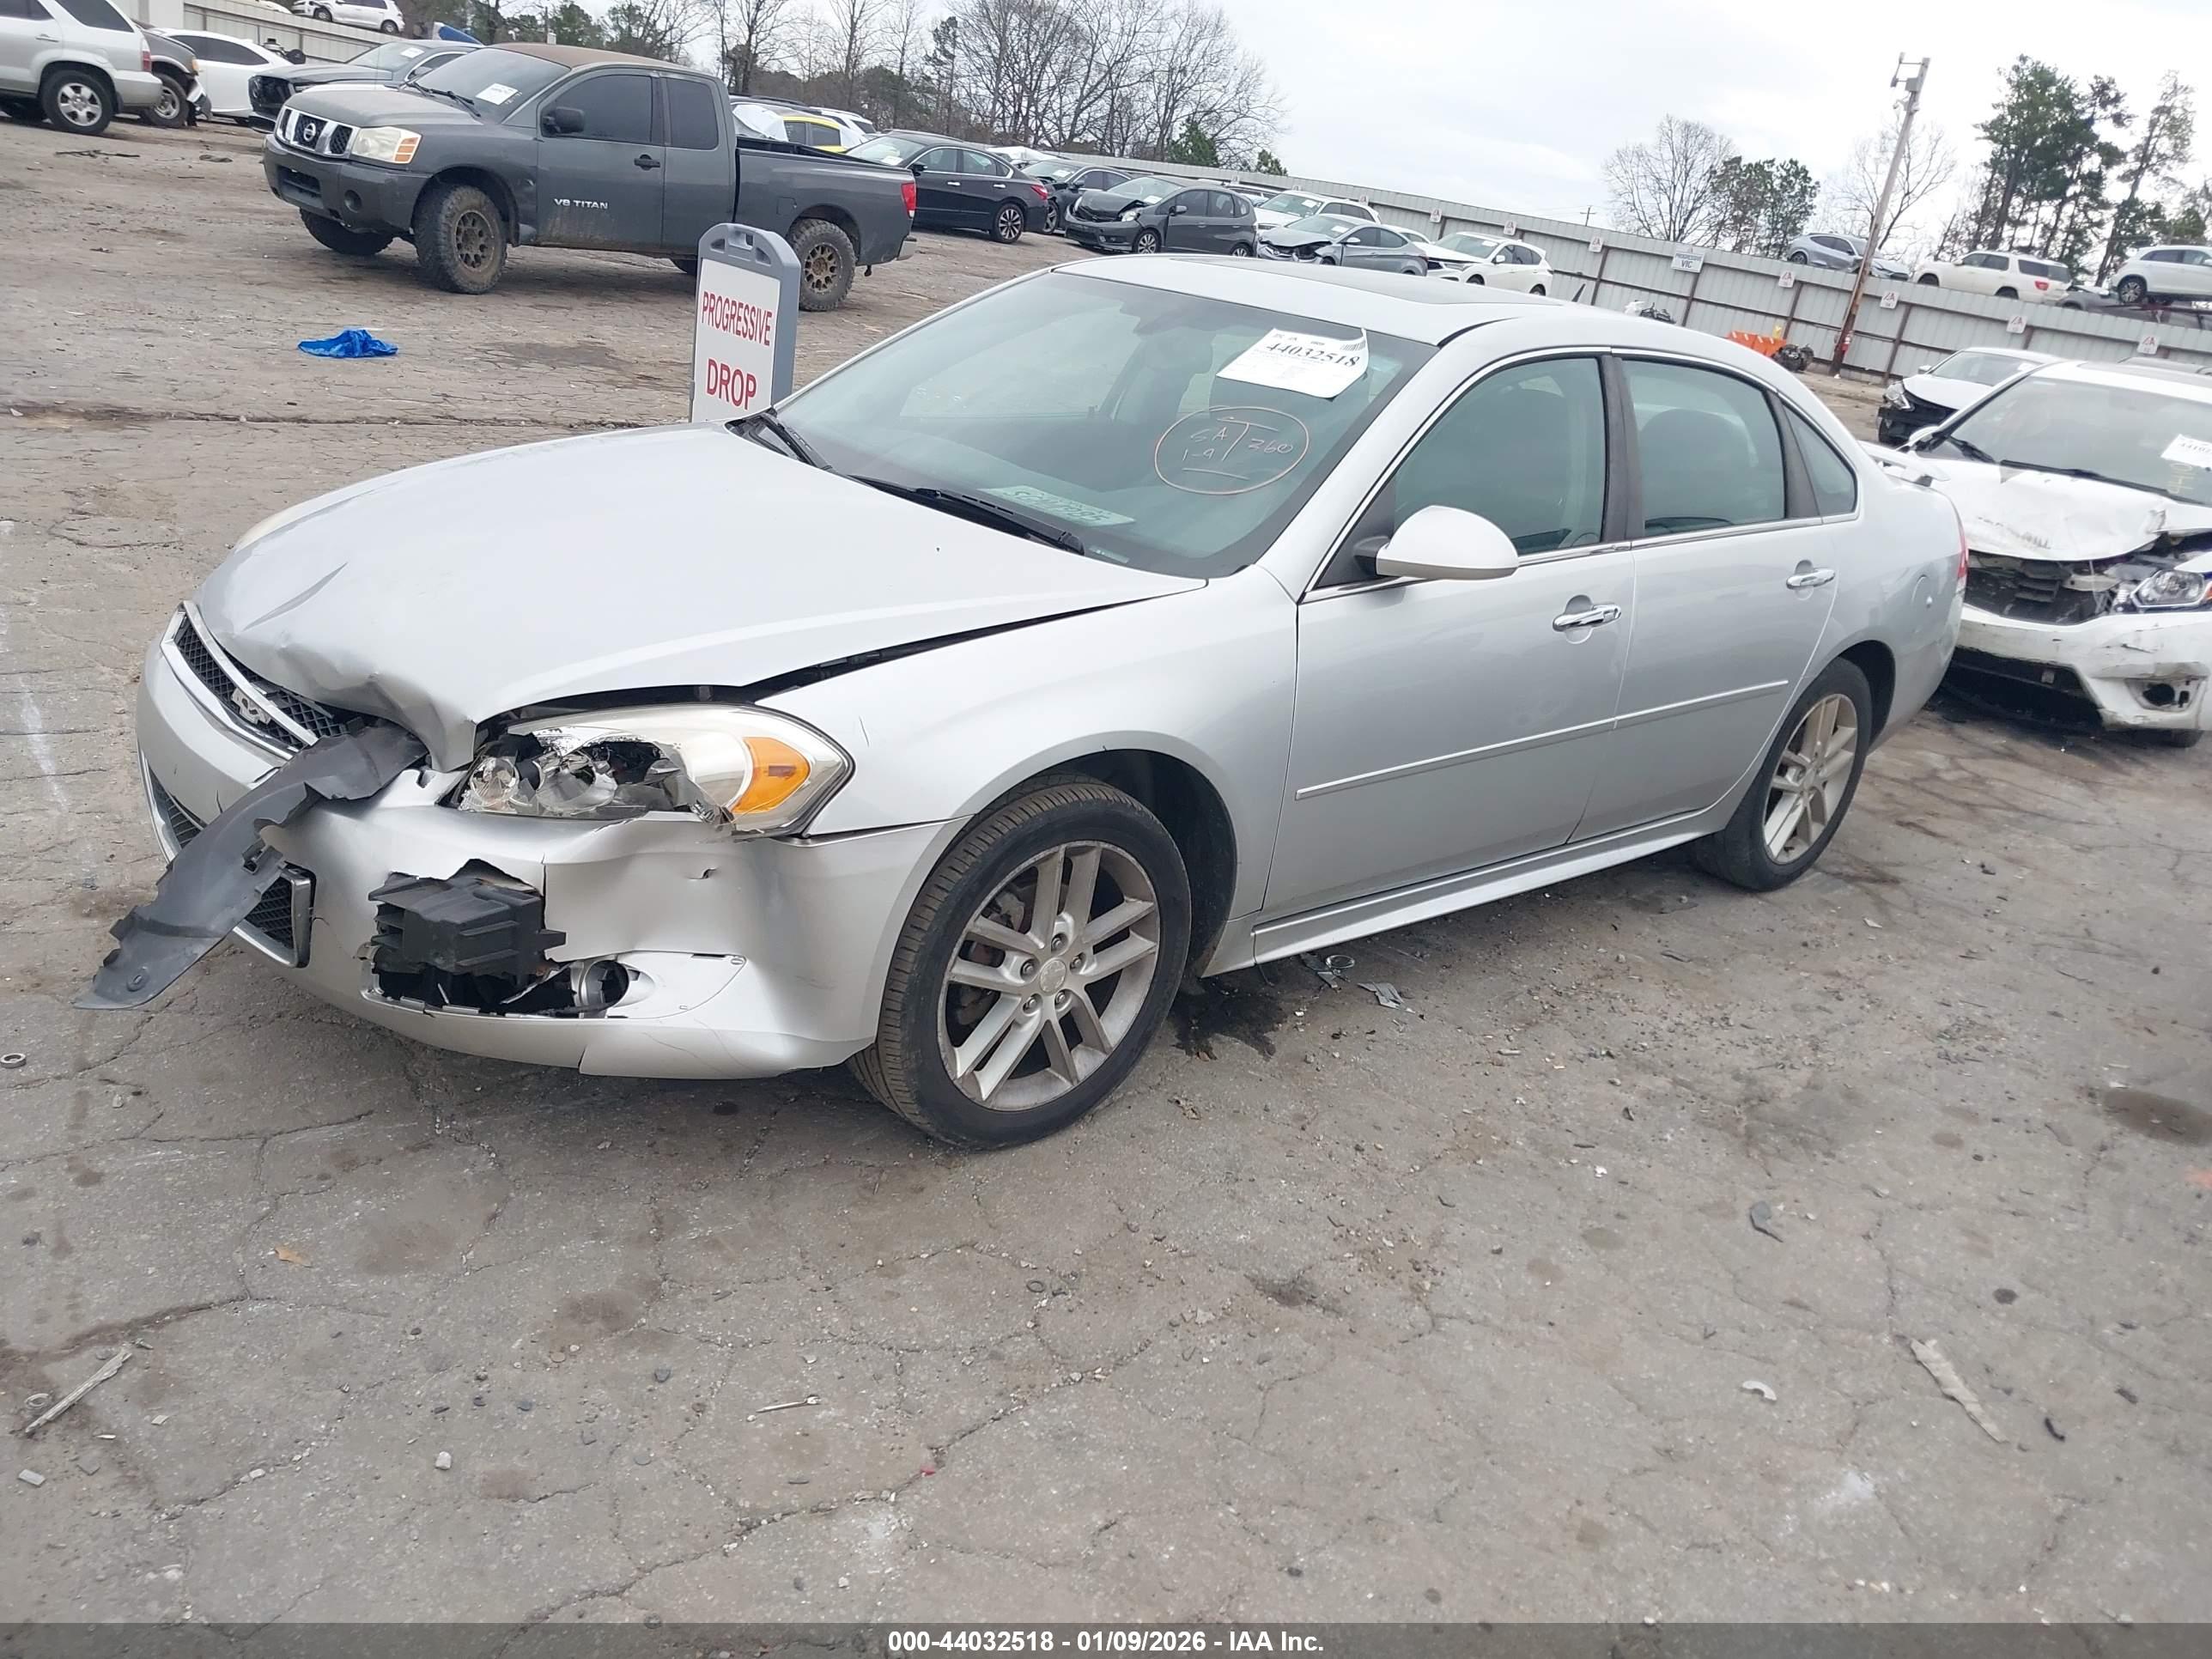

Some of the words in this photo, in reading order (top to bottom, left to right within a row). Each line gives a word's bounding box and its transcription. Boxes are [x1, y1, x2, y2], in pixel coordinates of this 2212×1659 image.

[554, 198, 571, 207] V8
[573, 200, 609, 210] TITAN
[1681, 260, 1693, 269] VIC
[702, 291, 773, 347] PROGRESSIVE
[1266, 343, 1361, 368] 44032518
[706, 358, 757, 410] DROP
